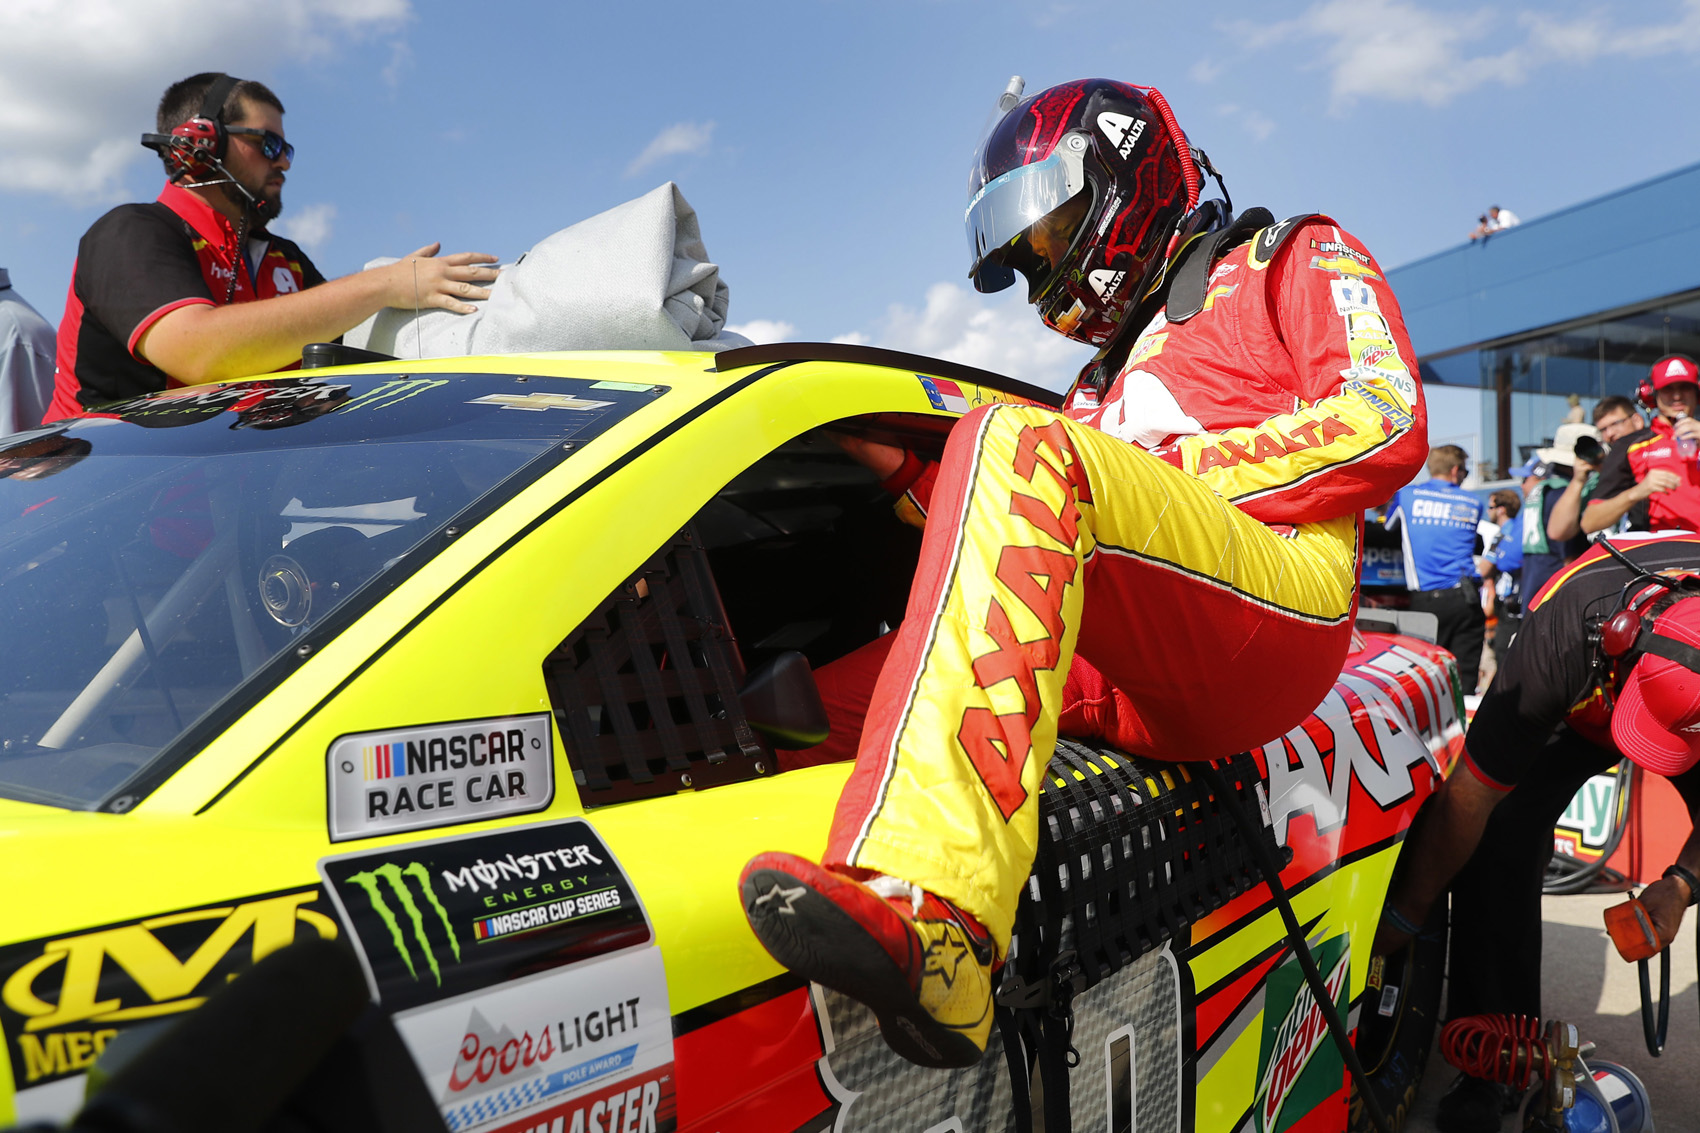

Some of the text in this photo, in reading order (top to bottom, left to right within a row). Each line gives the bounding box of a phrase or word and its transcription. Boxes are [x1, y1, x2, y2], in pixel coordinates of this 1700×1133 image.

[1118, 119, 1148, 161] AXALTA
[1325, 242, 1371, 265] NASCAR
[1101, 270, 1127, 305] AXALTA
[1349, 366, 1413, 393] SIENS
[1347, 380, 1413, 429] SUNOCO
[1197, 416, 1357, 475] AXALTA
[1412, 498, 1452, 519] CODE
[959, 419, 1094, 824] AXALTA
[406, 729, 526, 775] NASCAR
[369, 771, 527, 818] RACE CAR
[442, 844, 603, 893] MONSTER
[483, 875, 589, 908] ENERGY
[491, 889, 621, 936] NASCAR CUP SERIES
[448, 997, 640, 1092] Coors LIGHT
[562, 1055, 622, 1085] POLE AWARD
